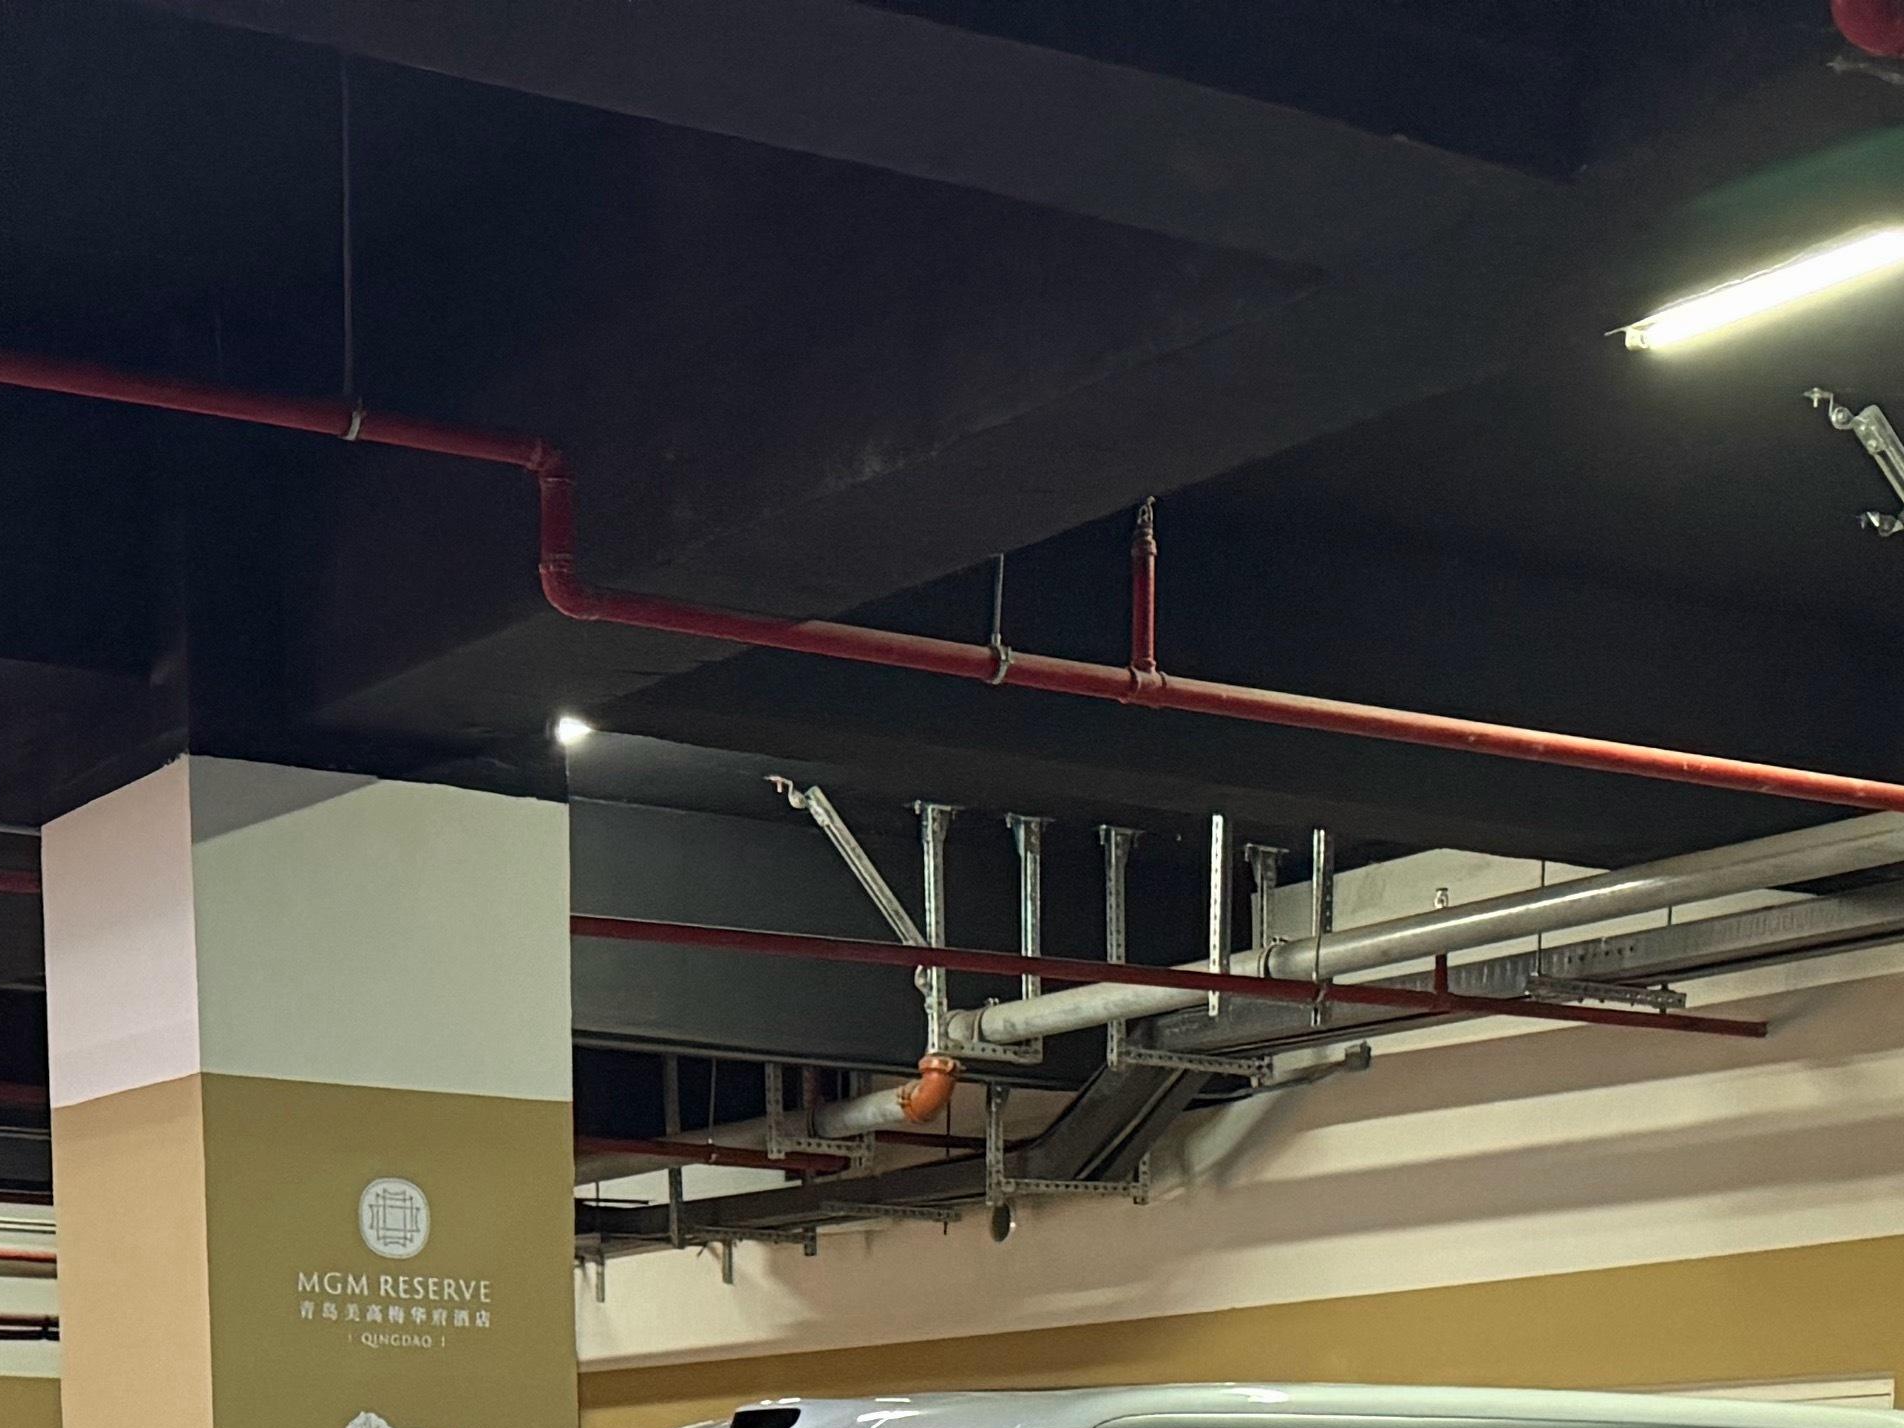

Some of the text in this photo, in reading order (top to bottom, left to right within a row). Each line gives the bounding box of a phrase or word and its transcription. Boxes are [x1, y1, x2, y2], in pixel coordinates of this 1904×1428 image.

[298, 1271, 492, 1303] MGM RESERVE
[361, 1331, 433, 1348] QINGDAO
